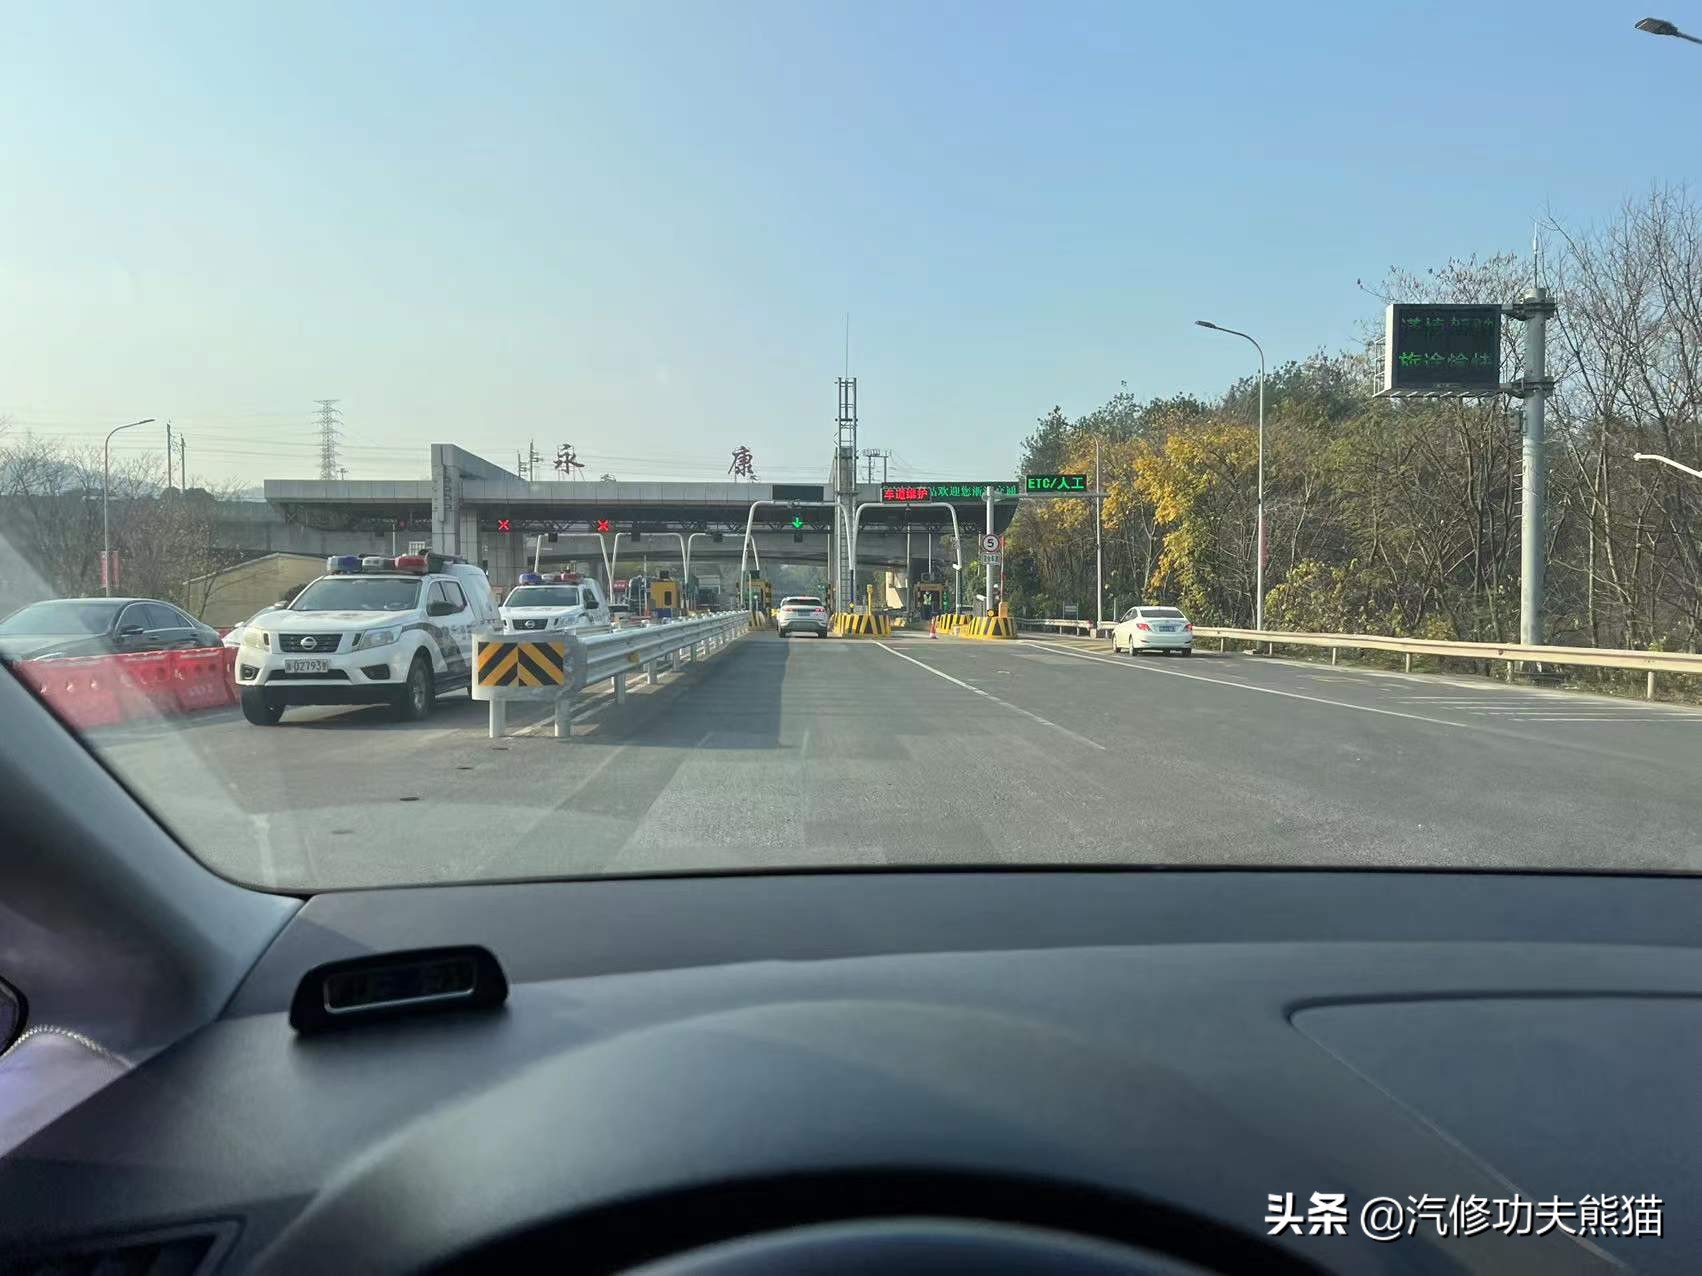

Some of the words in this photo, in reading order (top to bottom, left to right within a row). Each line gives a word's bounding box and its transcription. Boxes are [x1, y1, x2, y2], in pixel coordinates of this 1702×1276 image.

[728, 445, 755, 478] 康
[1028, 476, 1085, 490] ETC/人工
[987, 538, 995, 548] 5
